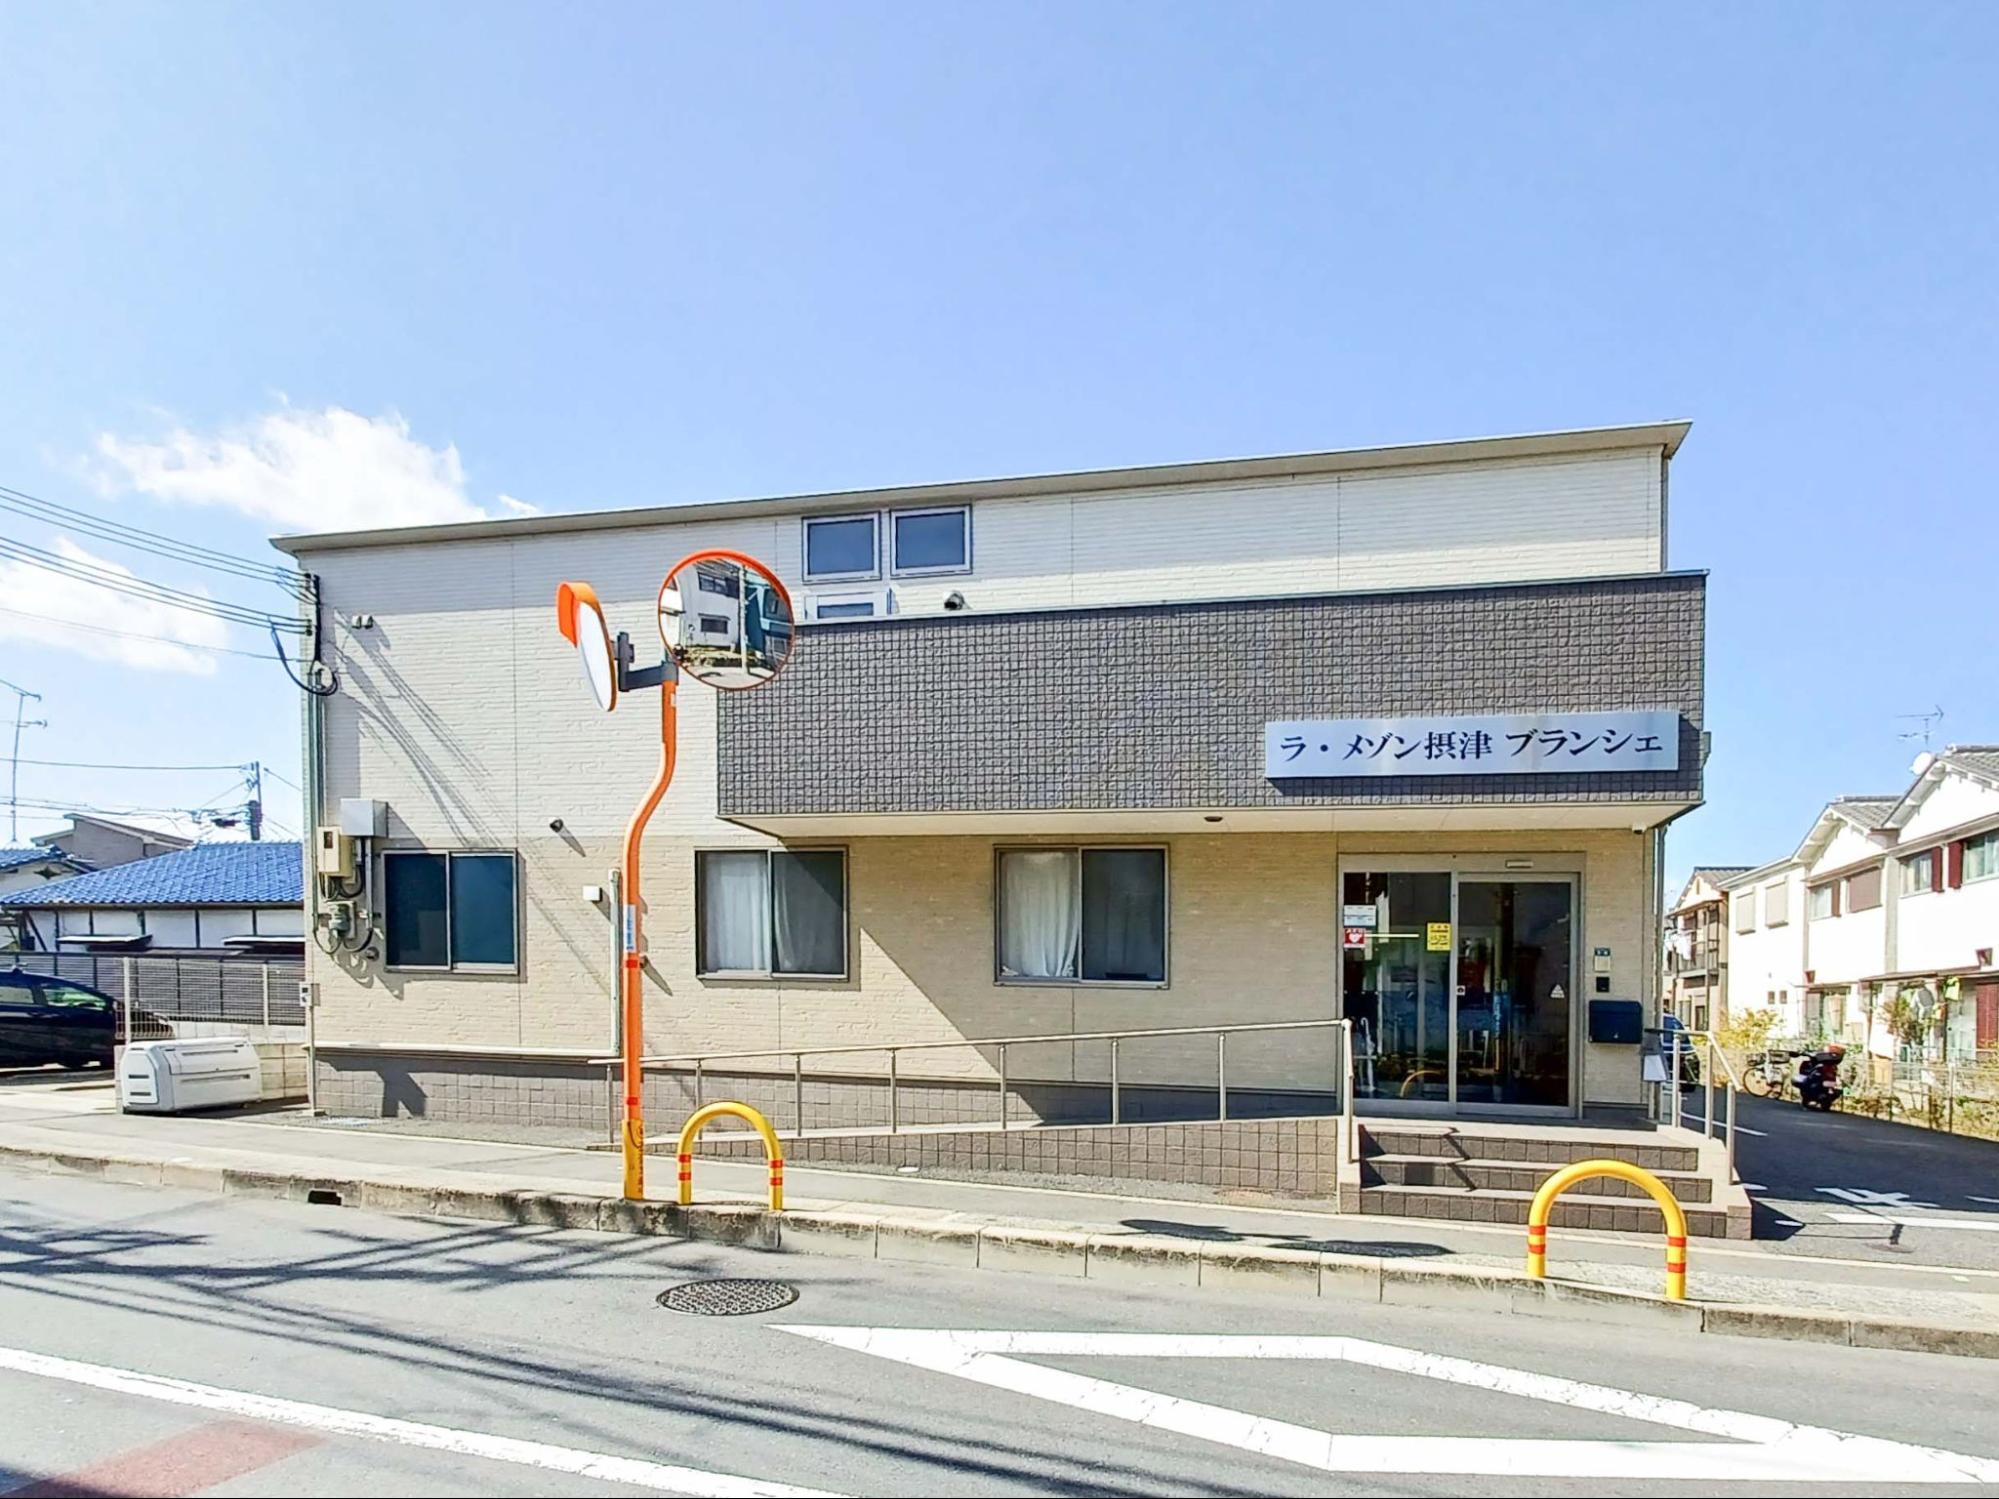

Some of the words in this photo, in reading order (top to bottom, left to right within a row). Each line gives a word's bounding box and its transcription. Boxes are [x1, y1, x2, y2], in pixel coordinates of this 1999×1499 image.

[1279, 731, 1493, 762] ラ・メゾン摂津
[1505, 728, 1664, 757] ブランシェ
